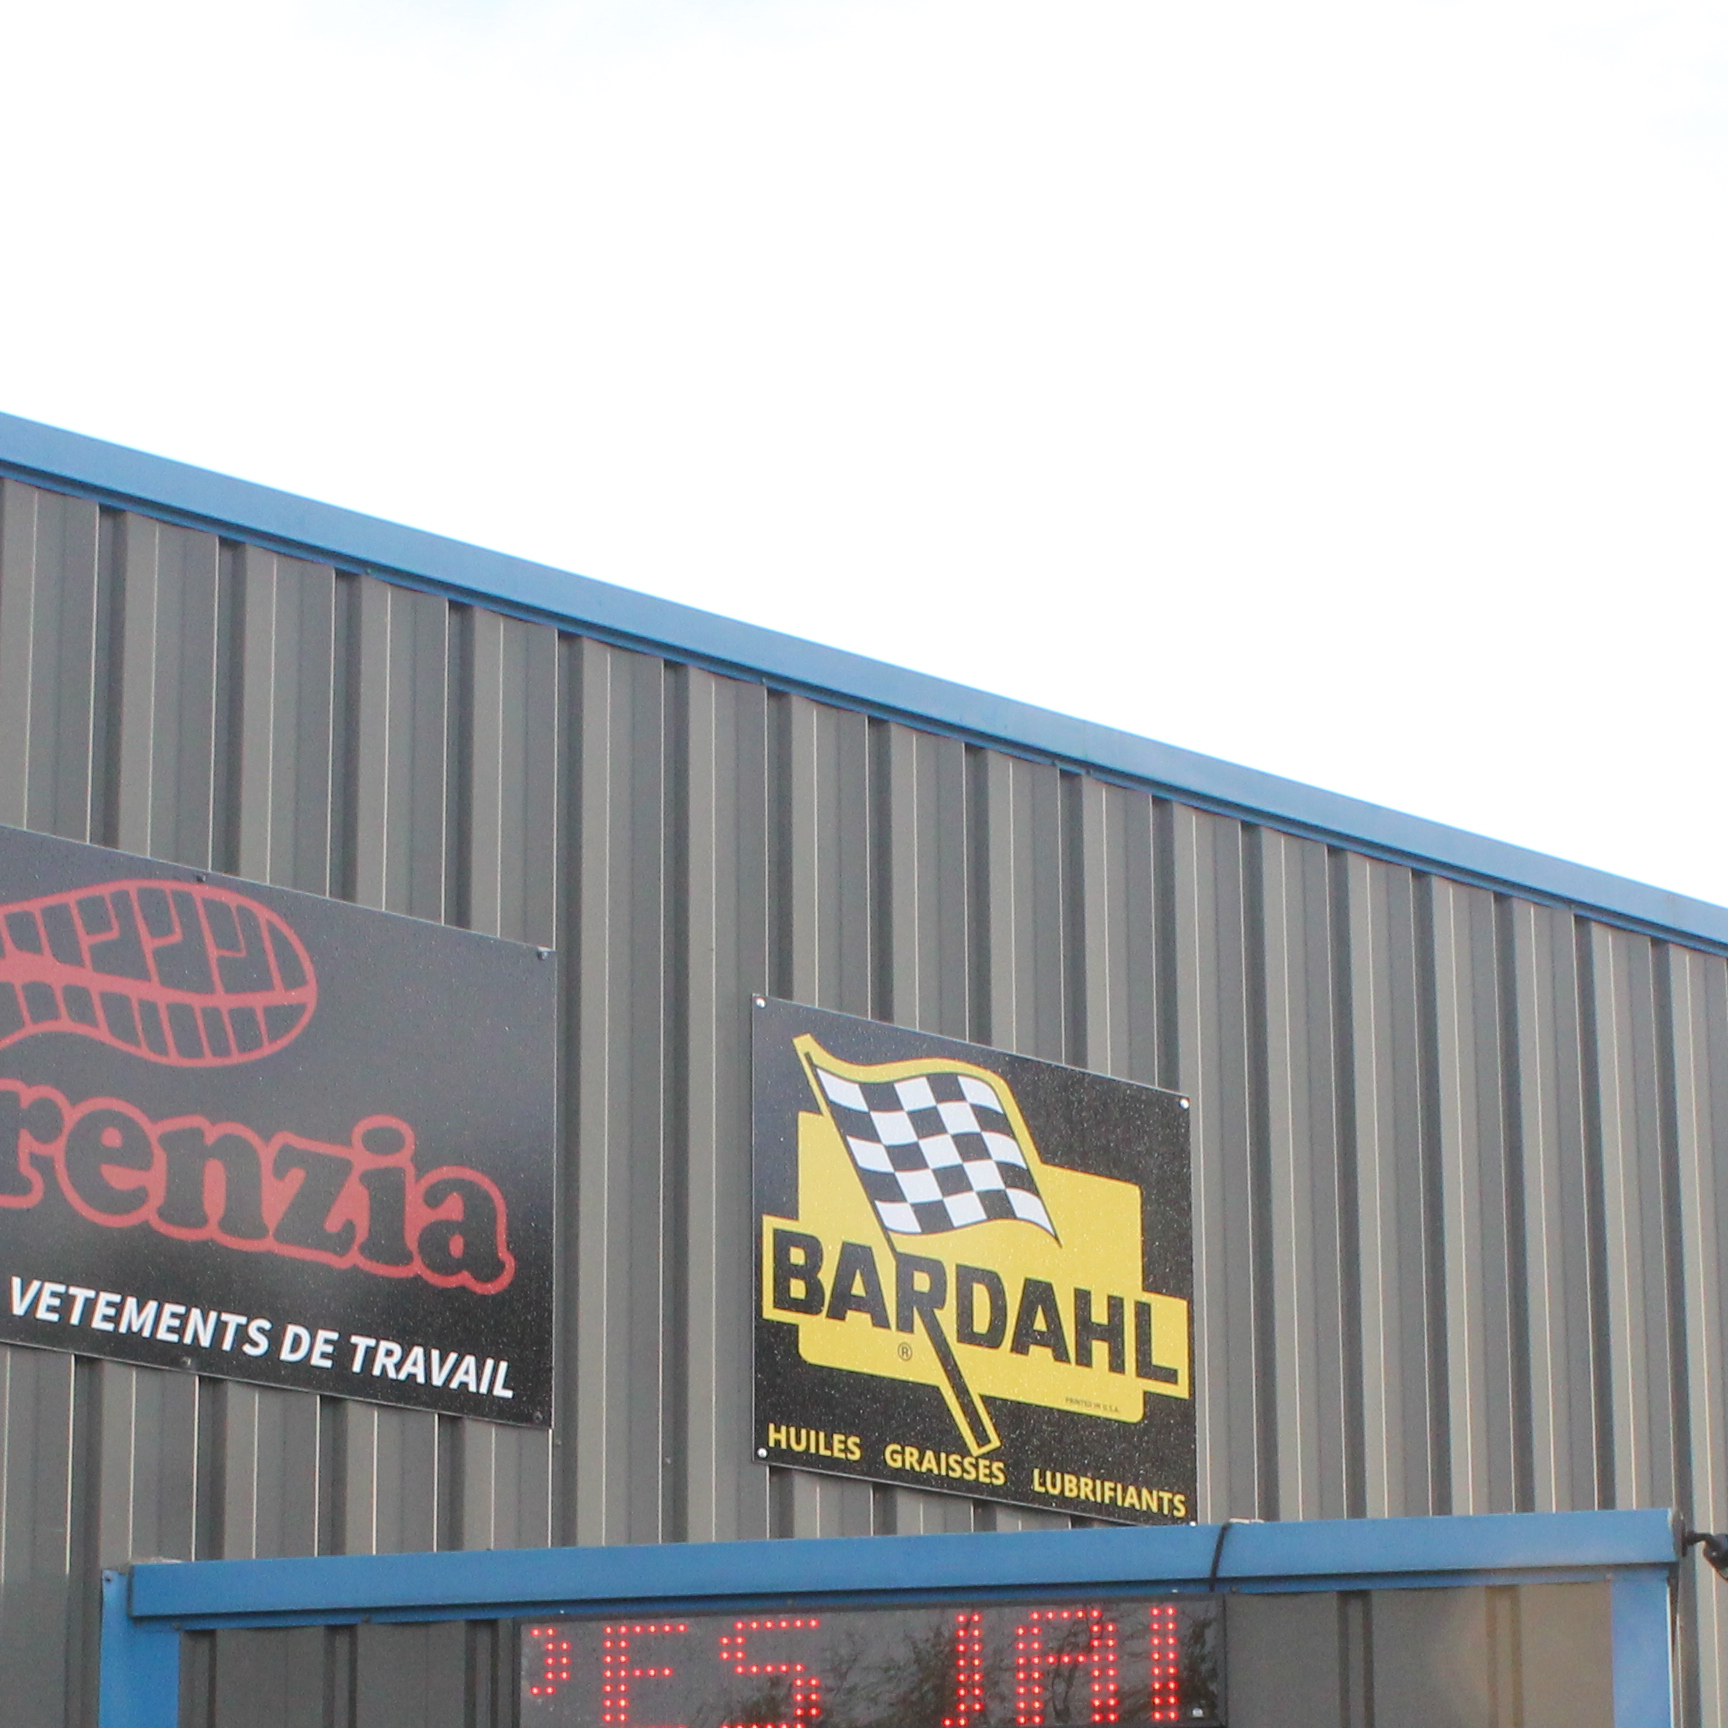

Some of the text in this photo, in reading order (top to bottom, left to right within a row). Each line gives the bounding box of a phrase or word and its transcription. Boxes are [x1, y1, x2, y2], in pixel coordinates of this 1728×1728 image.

[12, 1275, 272, 1358] VETEMENTS
[279, 1323, 339, 1369] DE
[349, 1334, 514, 1400] TRAVAIL
[772, 1227, 1178, 1387] BARDAHL
[767, 1422, 1188, 1518] HUILES GRAISSES LUBRIFIANTS
